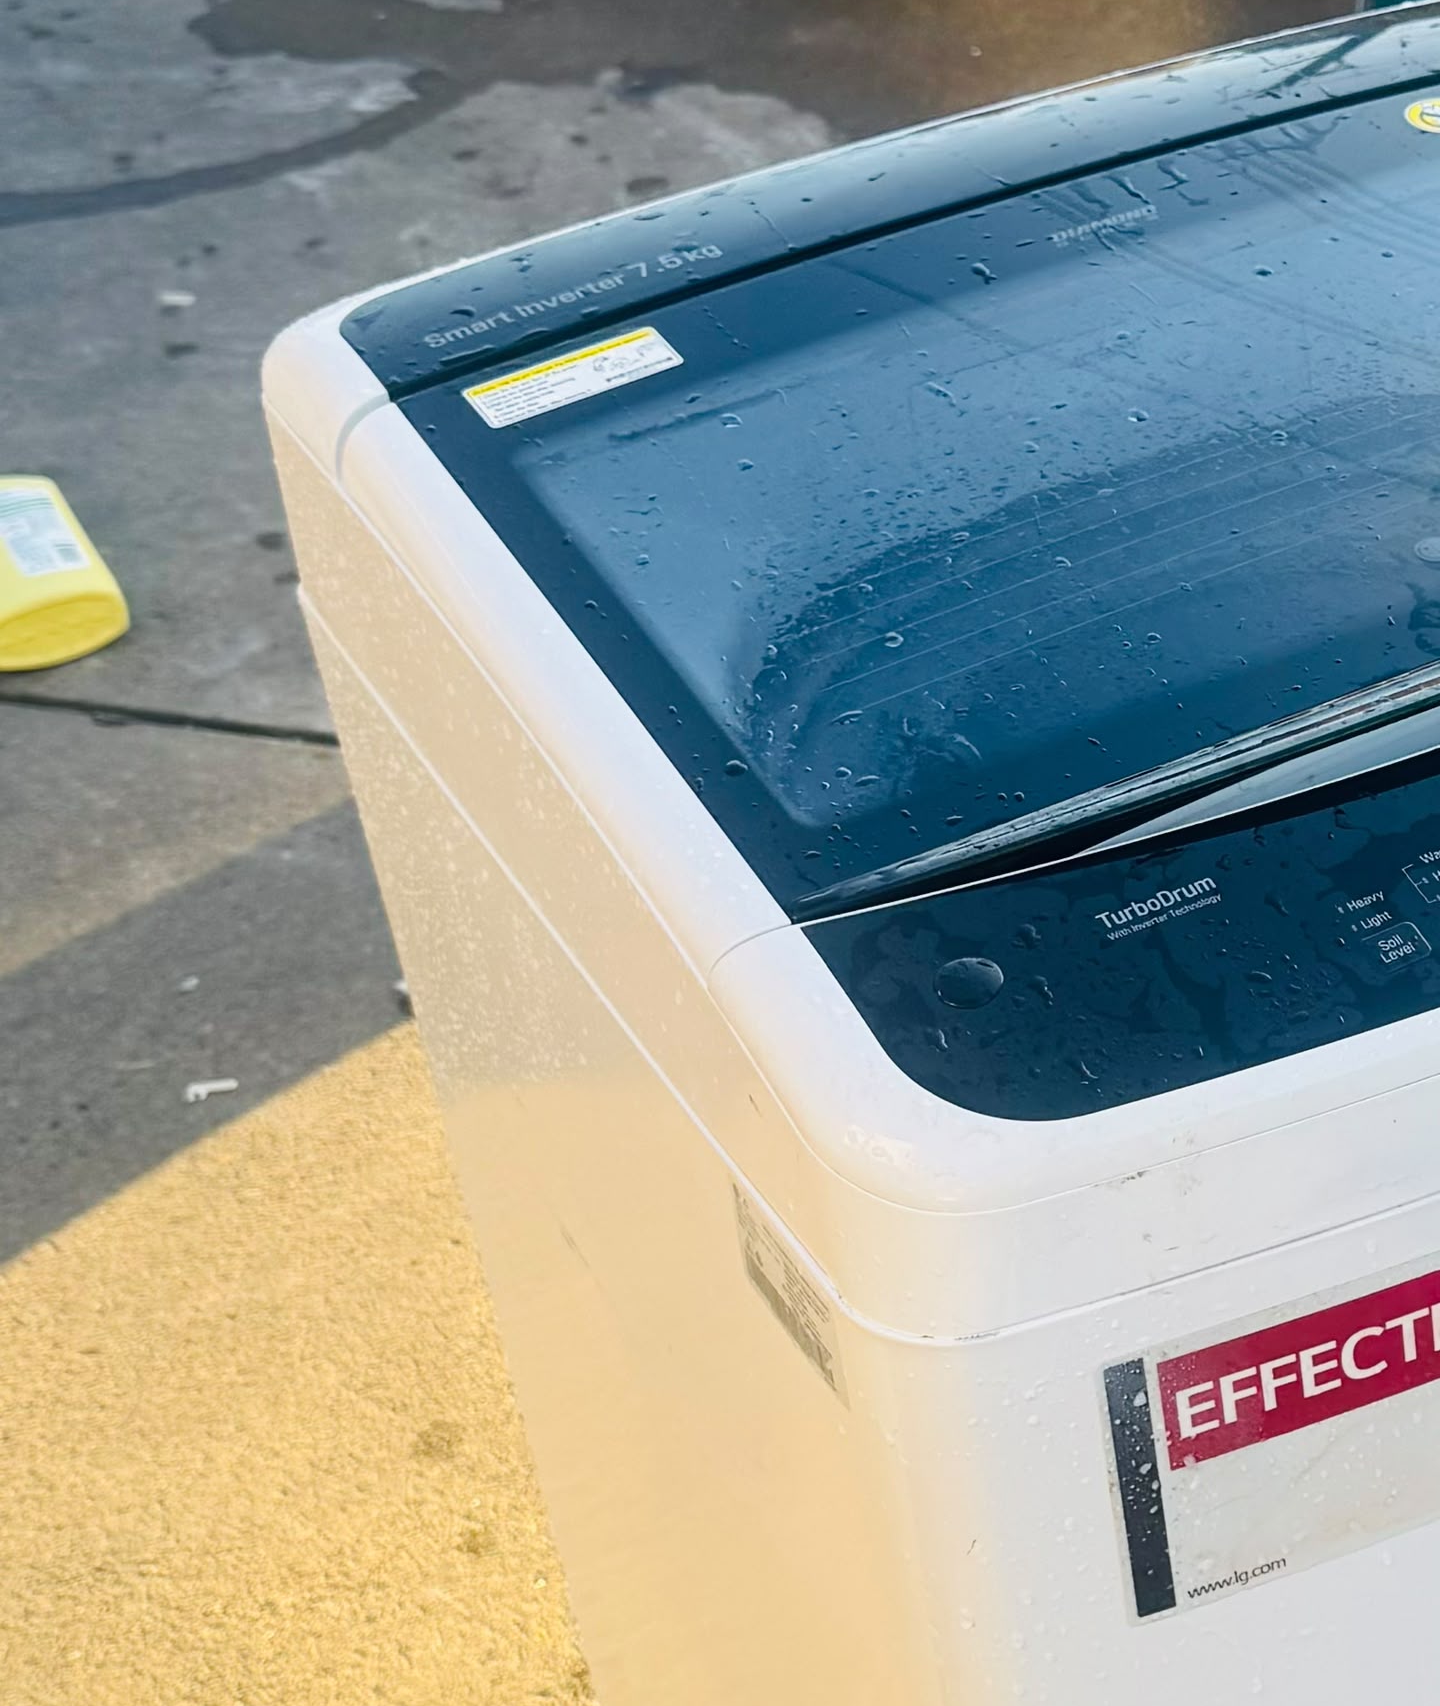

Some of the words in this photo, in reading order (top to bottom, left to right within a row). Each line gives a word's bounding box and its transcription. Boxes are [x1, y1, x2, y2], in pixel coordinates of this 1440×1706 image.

[423, 310, 516, 349] Smart
[514, 272, 627, 319] Inverter
[1095, 877, 1217, 928] TurboDrum
[1107, 926, 1131, 941] With
[1130, 913, 1168, 933] Inverter
[1169, 894, 1222, 918] Technology
[1346, 891, 1385, 912] Heavy
[1360, 911, 1392, 931] Light
[1378, 934, 1405, 953] Soil
[1380, 941, 1416, 964] Level
[1187, 1558, 1287, 1599] www.lg.com
